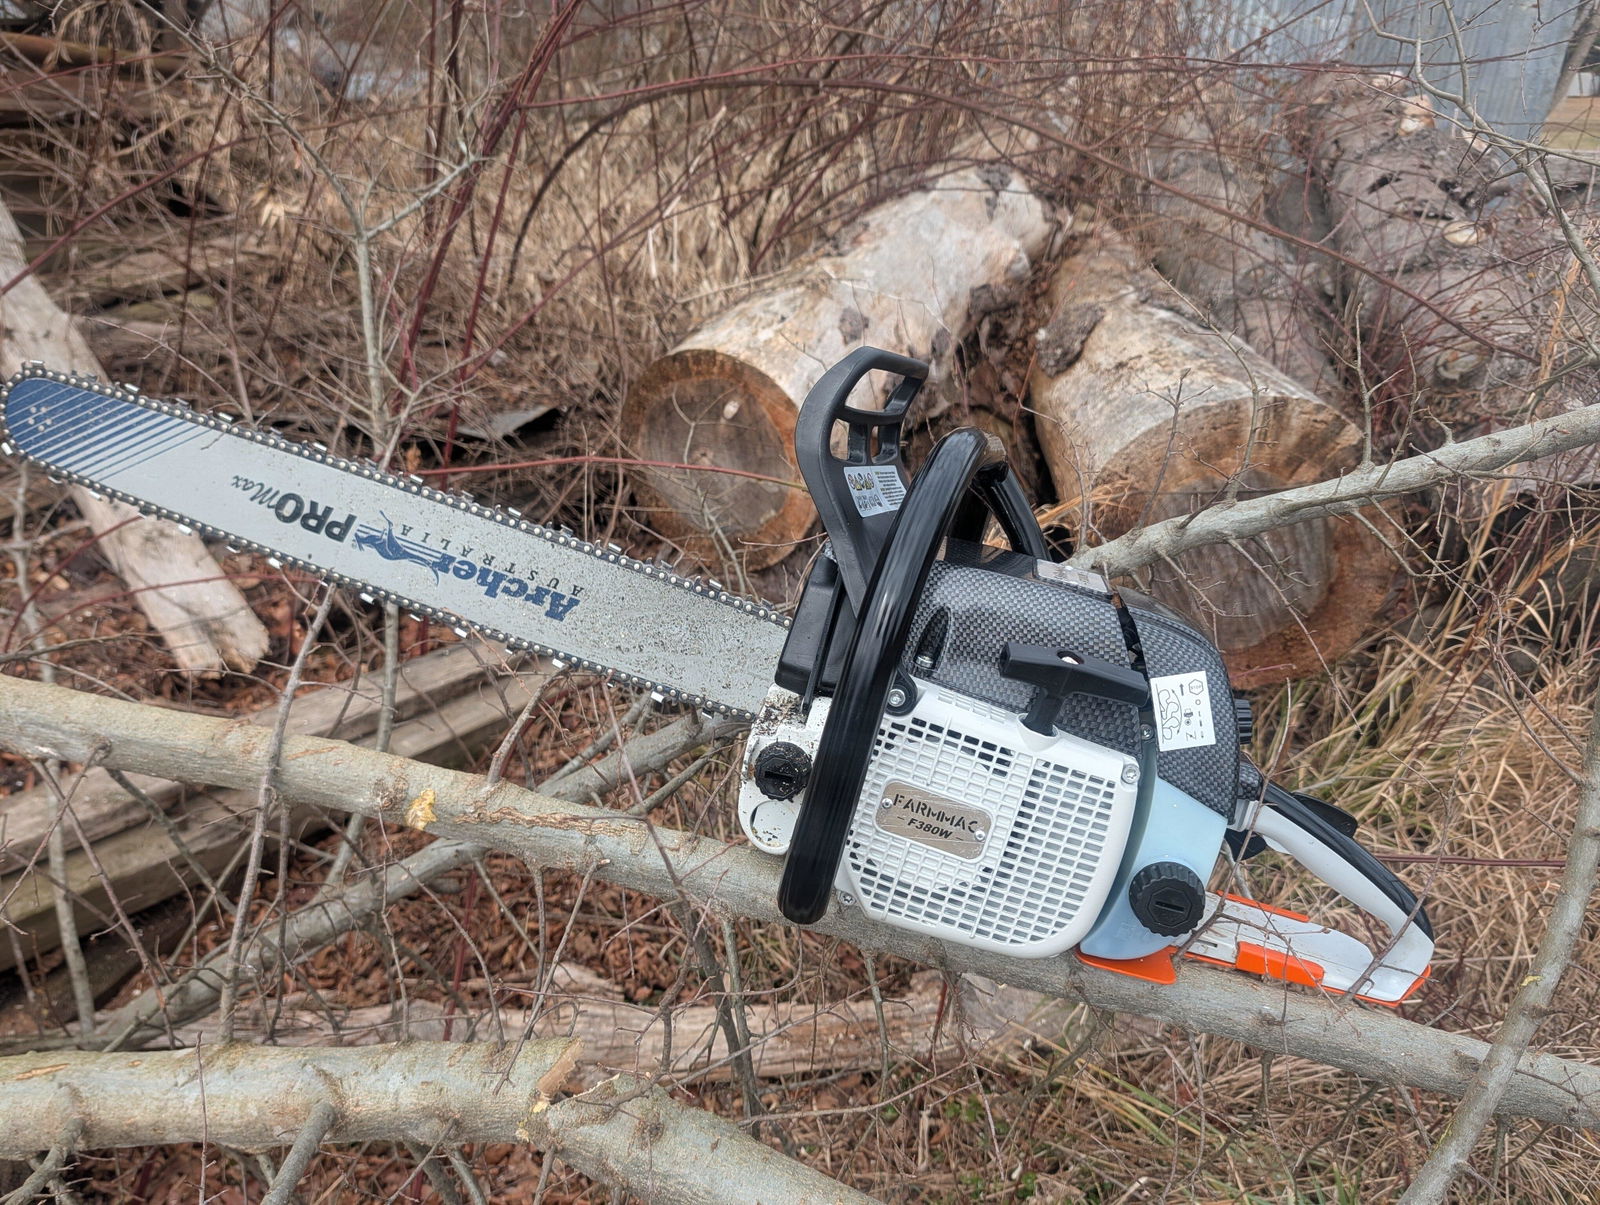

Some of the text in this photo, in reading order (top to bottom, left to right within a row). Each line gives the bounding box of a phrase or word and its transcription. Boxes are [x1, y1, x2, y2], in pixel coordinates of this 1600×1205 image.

[401, 524, 585, 597] AUSTRALIA
[431, 553, 580, 622] Archer
[893, 794, 978, 833] FARMMAC
[908, 818, 953, 839] F380W
